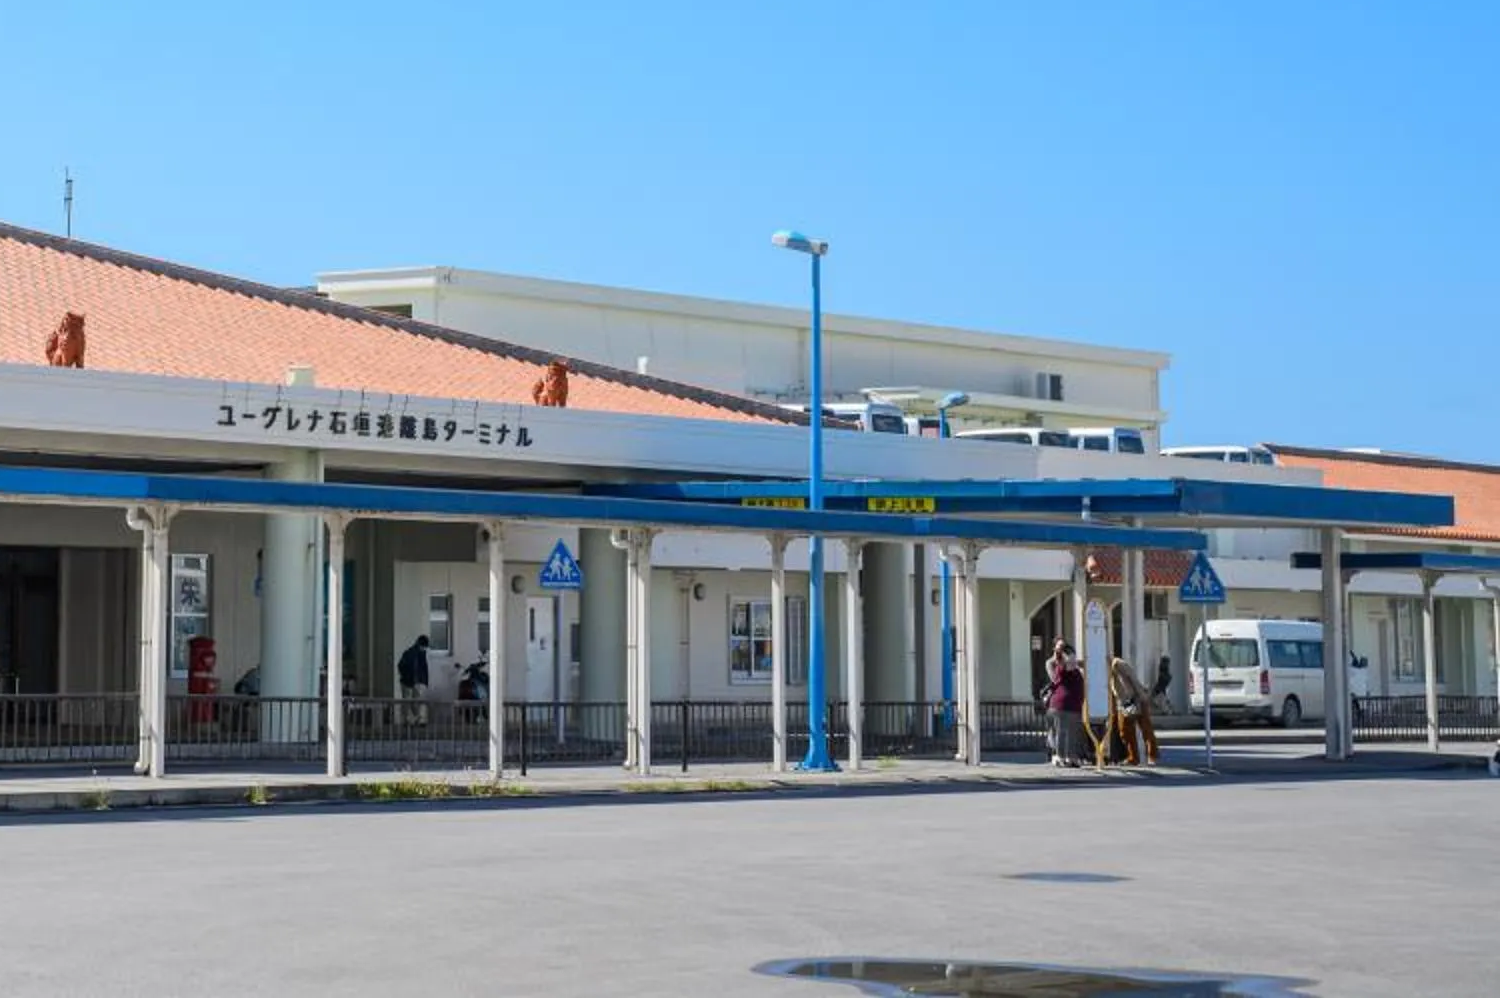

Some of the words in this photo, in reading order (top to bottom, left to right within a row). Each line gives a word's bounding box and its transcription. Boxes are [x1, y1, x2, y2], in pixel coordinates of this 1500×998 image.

[217, 404, 534, 448] ユーグレナ石垣港離島ターミナル
